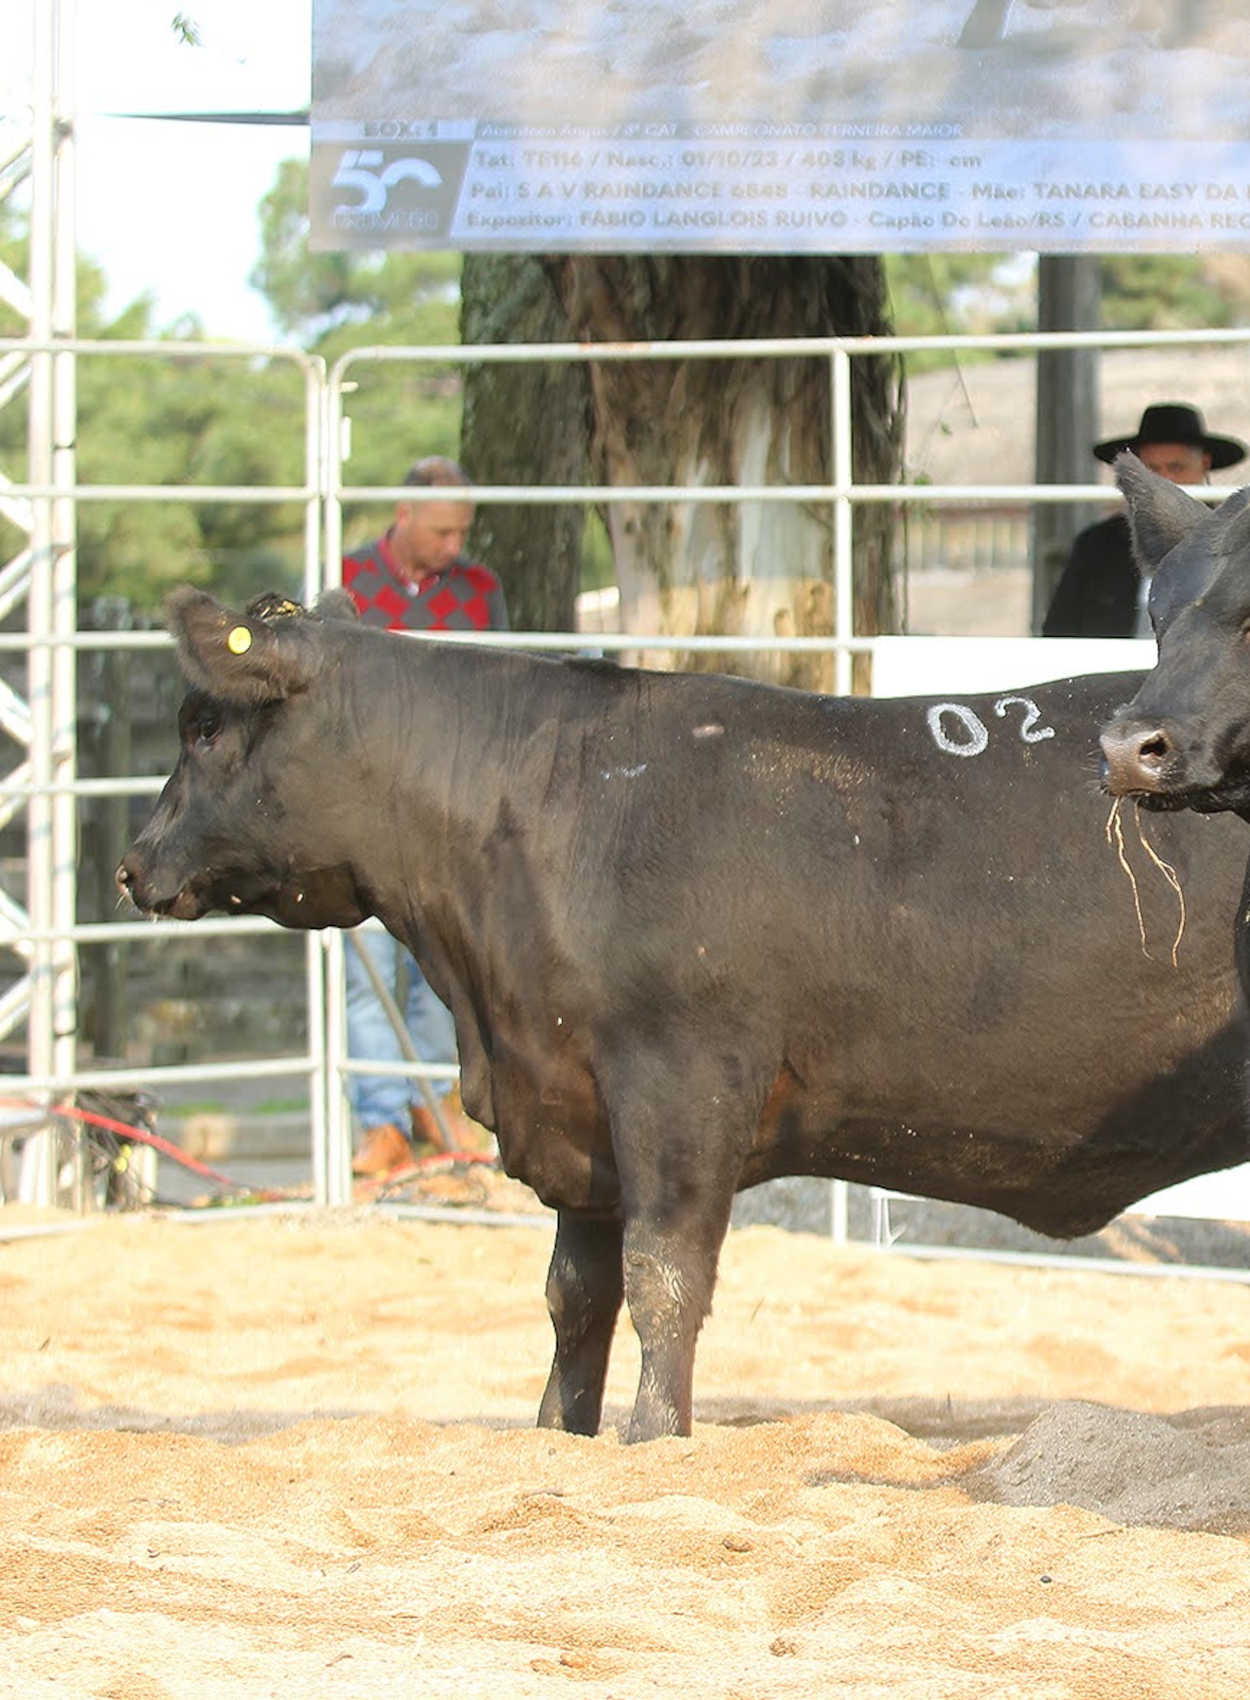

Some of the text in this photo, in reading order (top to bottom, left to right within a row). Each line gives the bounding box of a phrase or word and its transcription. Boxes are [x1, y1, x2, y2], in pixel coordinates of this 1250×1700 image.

[906, 124, 963, 137] MAIOR
[475, 151, 515, 167] Tat:
[608, 151, 674, 167] Nasc.:
[681, 150, 778, 168] 01/10/23
[852, 150, 877, 171] kg
[901, 151, 935, 167] PE:
[950, 156, 982, 168] cm
[471, 182, 509, 199] Pai:
[517, 182, 530, 198] S
[538, 182, 553, 198] A
[562, 182, 577, 198] V
[585, 182, 724, 199] RAINDANCE
[809, 183, 951, 200] RAINDANCE
[1033, 183, 1132, 200] TANARA
[1139, 184, 1199, 200] EASY
[1205, 184, 1238, 200] DA
[467, 211, 571, 231] Expositor:
[654, 211, 769, 228] LANGLOIS
[776, 211, 847, 228] RUIVO
[868, 211, 934, 231] Capão
[978, 211, 1066, 229] Leão/RS
[1088, 212, 1202, 229] CABANHA
[926, 697, 1056, 757] 02
